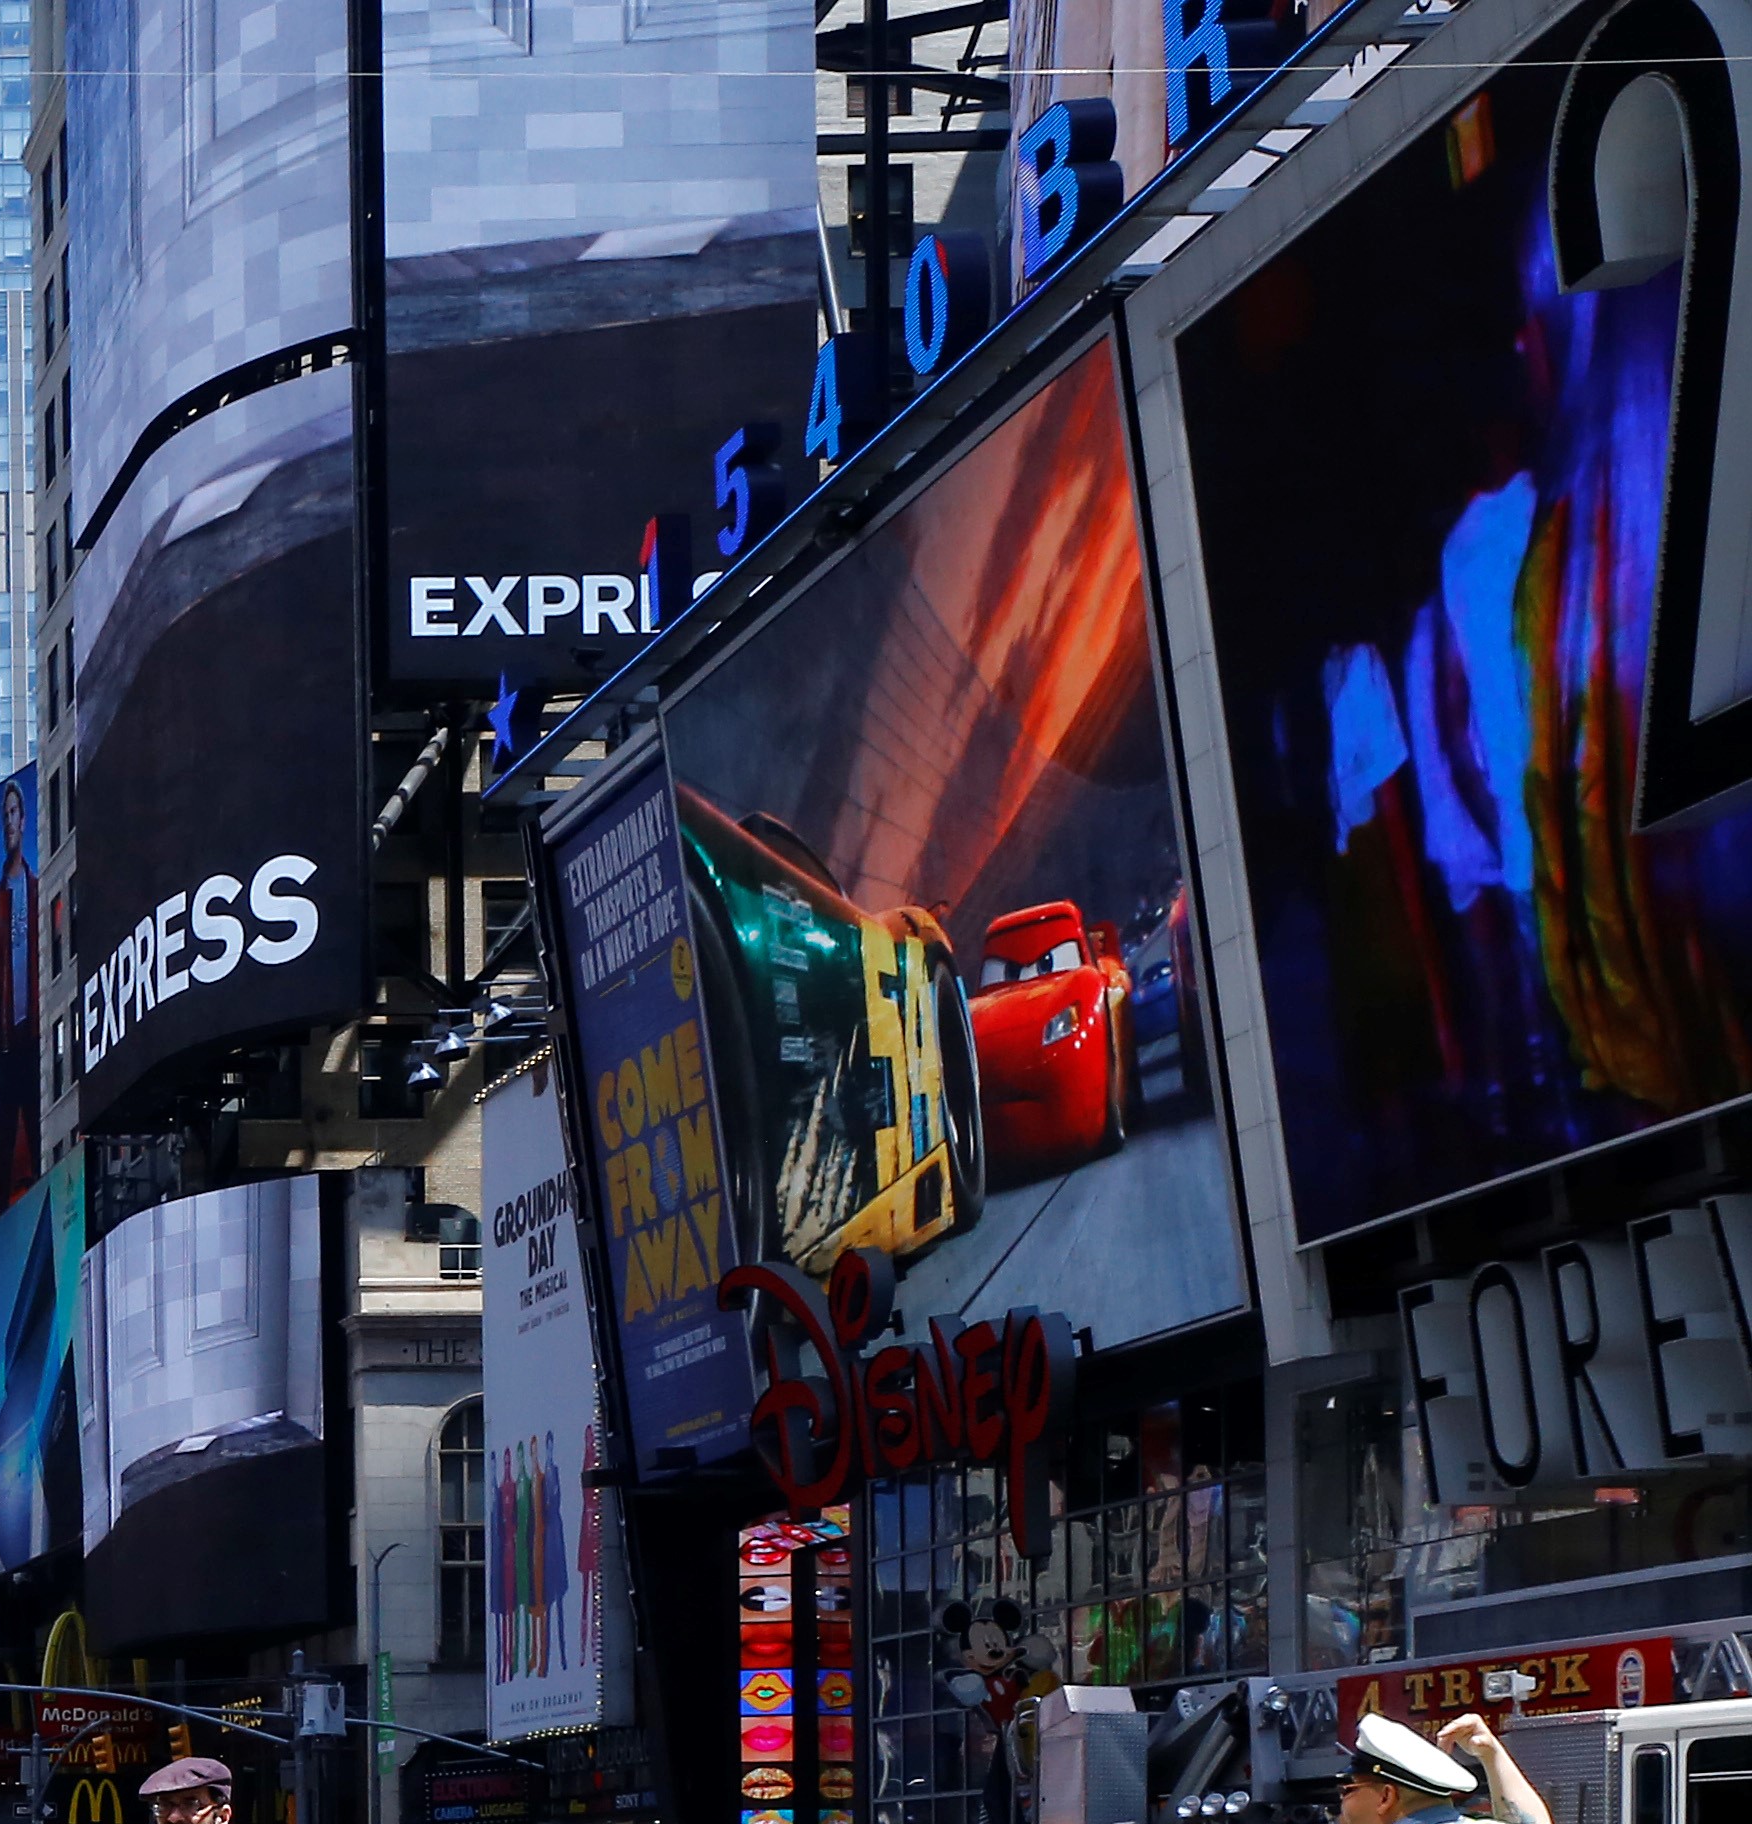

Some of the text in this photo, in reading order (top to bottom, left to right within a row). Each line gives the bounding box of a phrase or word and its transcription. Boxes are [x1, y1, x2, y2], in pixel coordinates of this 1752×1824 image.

[1018, 0, 1230, 282] BR
[410, 572, 668, 637] EXPR
[584, 852, 663, 942] TRANSPORTS US
[84, 853, 319, 1075] EXPRESS
[603, 920, 636, 974] WAVE
[634, 910, 648, 953] OF
[597, 1018, 707, 1151] COME
[605, 1103, 719, 1238] FROM
[492, 1169, 570, 1248] GROUNDH
[528, 1223, 558, 1279] DAY
[624, 1192, 721, 1323] AWAY
[519, 1269, 568, 1310] THE MUSICAL
[415, 1339, 468, 1363] THE
[41, 1707, 154, 1722] McDonald's
[542, 1691, 583, 1710] BROADWAY
[1356, 1653, 1591, 1719] 4 TRCK
[434, 1805, 475, 1820] CAMERA
